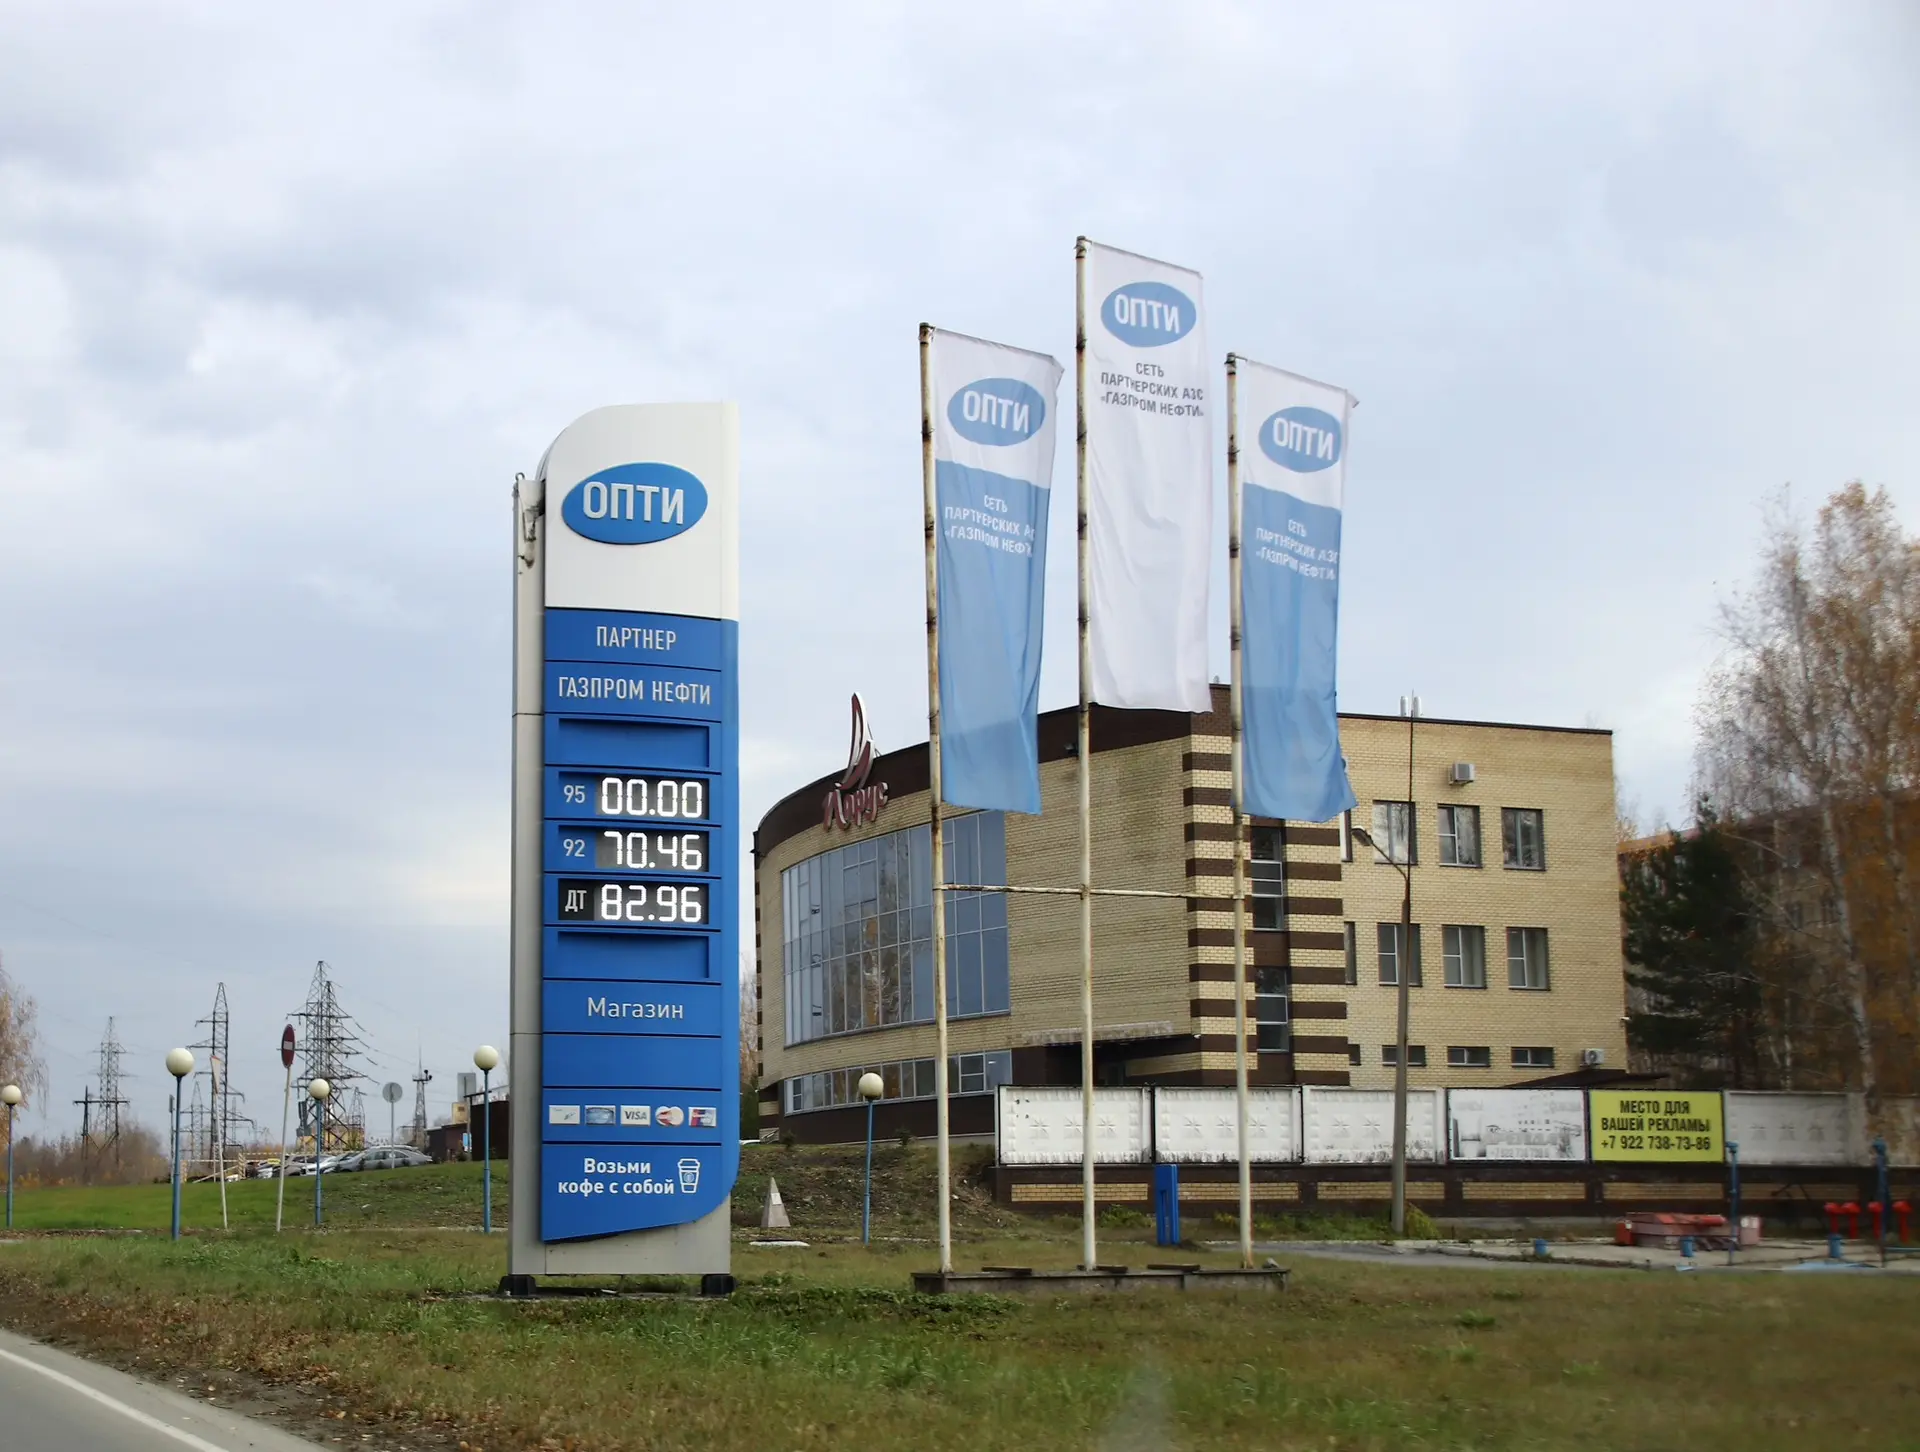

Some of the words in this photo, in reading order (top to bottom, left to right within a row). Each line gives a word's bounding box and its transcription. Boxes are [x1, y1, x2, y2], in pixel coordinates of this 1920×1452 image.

[1114, 293, 1179, 334] ОПТИ
[1136, 362, 1164, 377] СЕТЬ
[1182, 388, 1203, 400] АЗС
[963, 390, 1029, 433] ОПТИ
[1273, 417, 1333, 460] ОПТИ
[582, 481, 684, 525] ОПТИ
[984, 495, 1008, 513] СЕТЬ
[596, 626, 677, 650] ПАРТНЕР
[558, 676, 644, 700] ГАЗПРОМ
[652, 680, 711, 705] НЕФТИ
[563, 785, 585, 803] 95
[601, 777, 702, 818] 00.00
[563, 839, 585, 857] 92
[604, 831, 701, 870] 70.46
[565, 889, 587, 912] ДТ
[601, 884, 701, 922] 82.96
[587, 997, 684, 1019] Магазин
[624, 1110, 647, 1120] VISA
[1620, 1100, 1660, 1114] МЕСТО
[1664, 1101, 1690, 1116] ДЛЯ
[1601, 1115, 1644, 1131] ВАШЕЙ
[1648, 1118, 1711, 1132] РЕКЛАМЫ
[1601, 1135, 1616, 1149] +7
[1620, 1135, 1644, 1149] 922
[1648, 1136, 1711, 1150] 738-73-86
[584, 1158, 651, 1174] Возьми
[558, 1178, 605, 1197] кофе
[609, 1182, 619, 1194] с
[623, 1179, 674, 1194] собой
